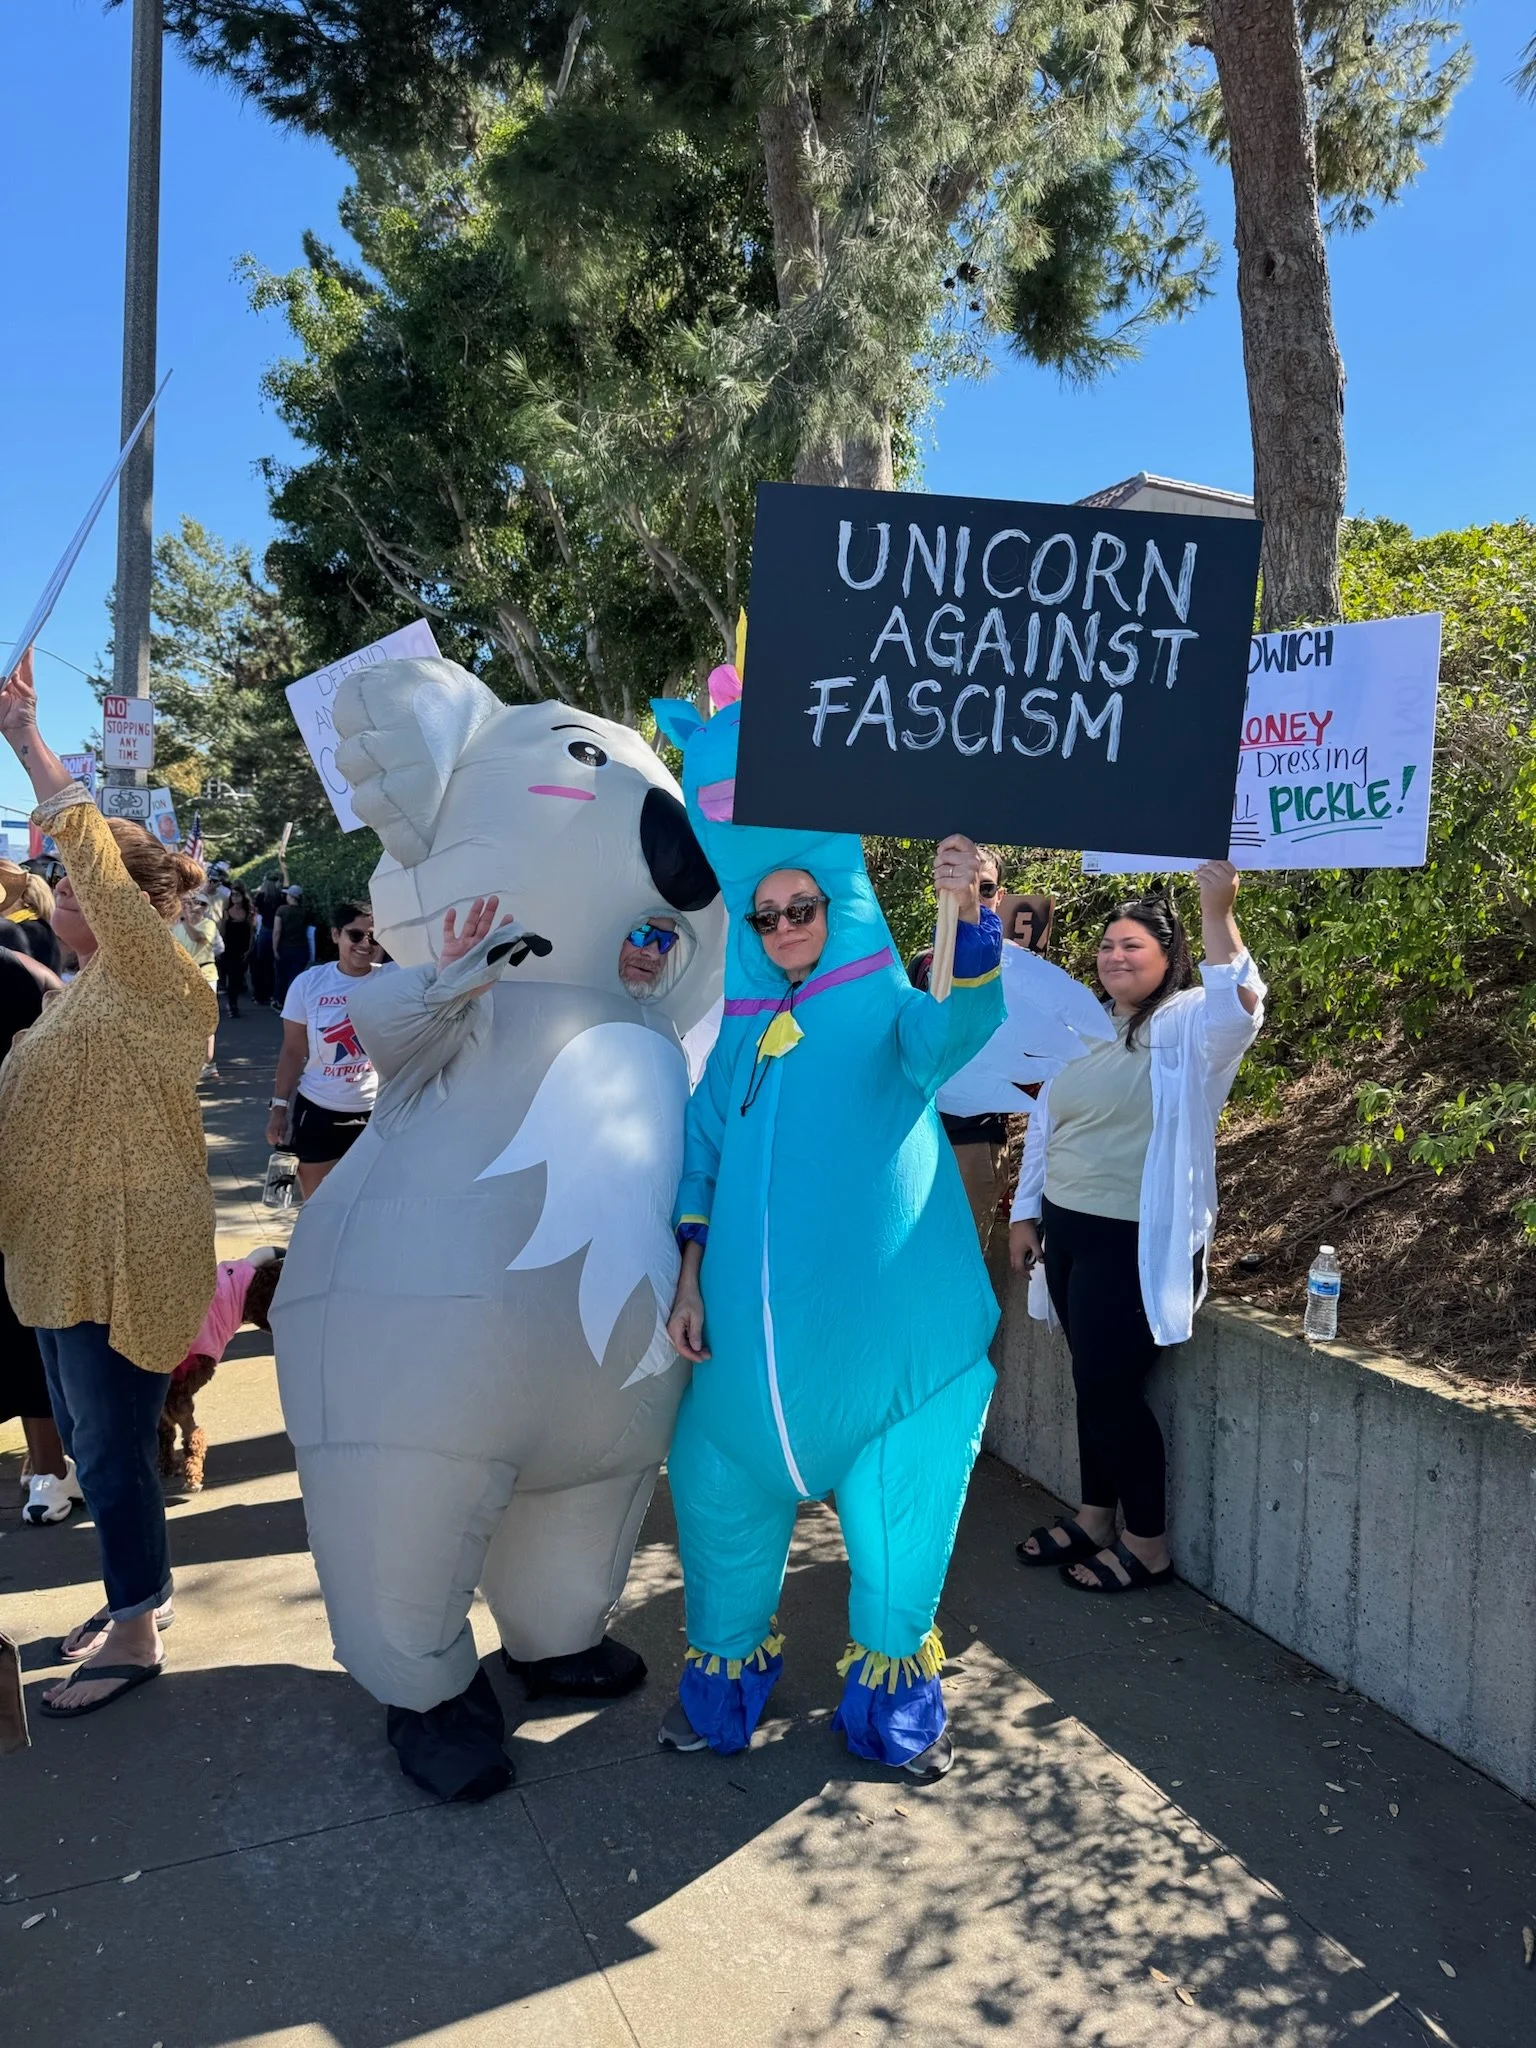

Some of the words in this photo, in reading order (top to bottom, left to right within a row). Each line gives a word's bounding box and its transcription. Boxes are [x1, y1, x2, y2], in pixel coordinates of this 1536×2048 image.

[837, 520, 1198, 623] UNICORN
[869, 602, 1200, 689] AGAINST
[315, 644, 389, 696] DEFEND
[107, 700, 126, 716] NO
[107, 721, 150, 736] STOPPING
[803, 674, 1123, 763] FASCISM
[1240, 710, 1334, 746] ONEY
[118, 749, 139, 760] TIME
[120, 738, 137, 748] ANY
[1257, 742, 1368, 789] Dressing
[1269, 765, 1417, 834] PICKLE!
